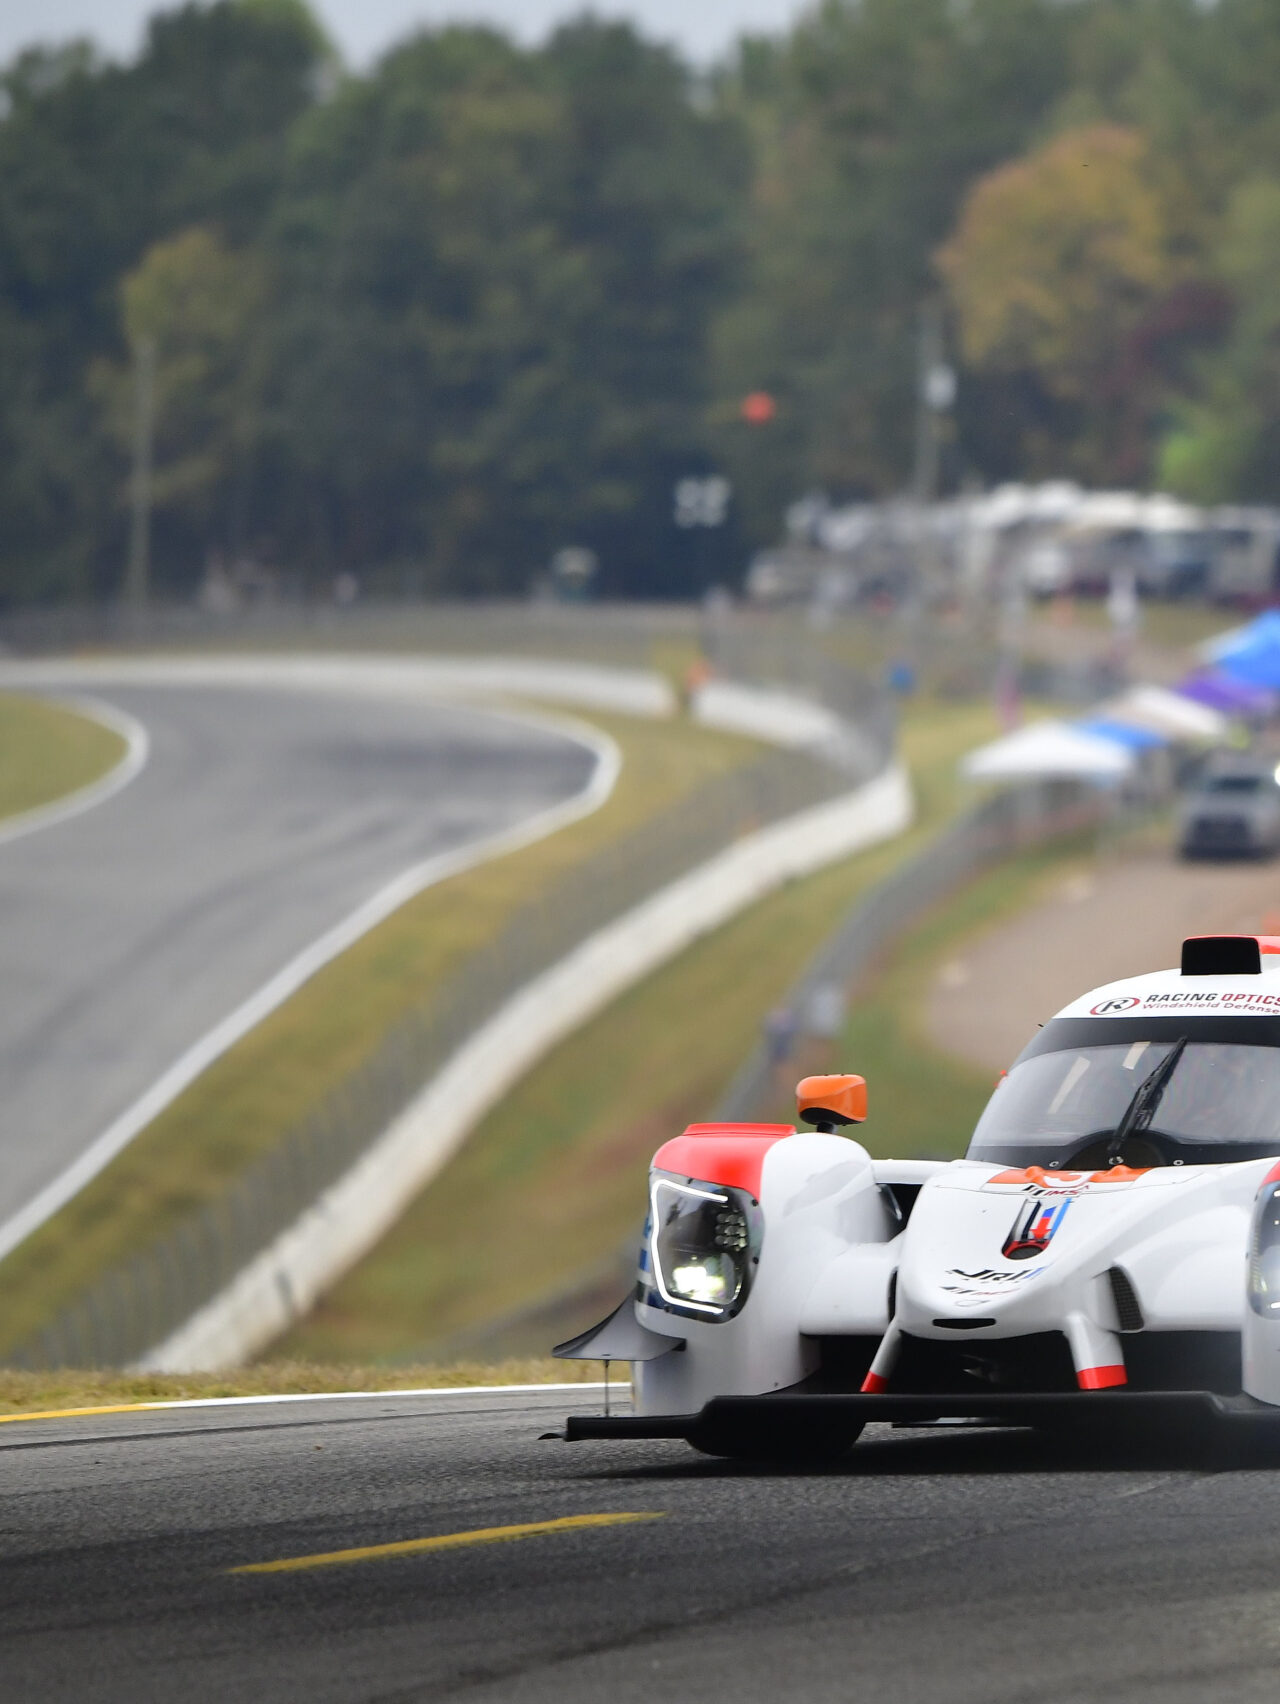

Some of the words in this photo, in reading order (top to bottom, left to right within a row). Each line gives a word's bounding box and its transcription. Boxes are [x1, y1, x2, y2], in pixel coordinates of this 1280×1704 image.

[1146, 993, 1218, 1003] RACING
[1143, 1002, 1220, 1010] Windshield
[1223, 1003, 1280, 1014] Defense
